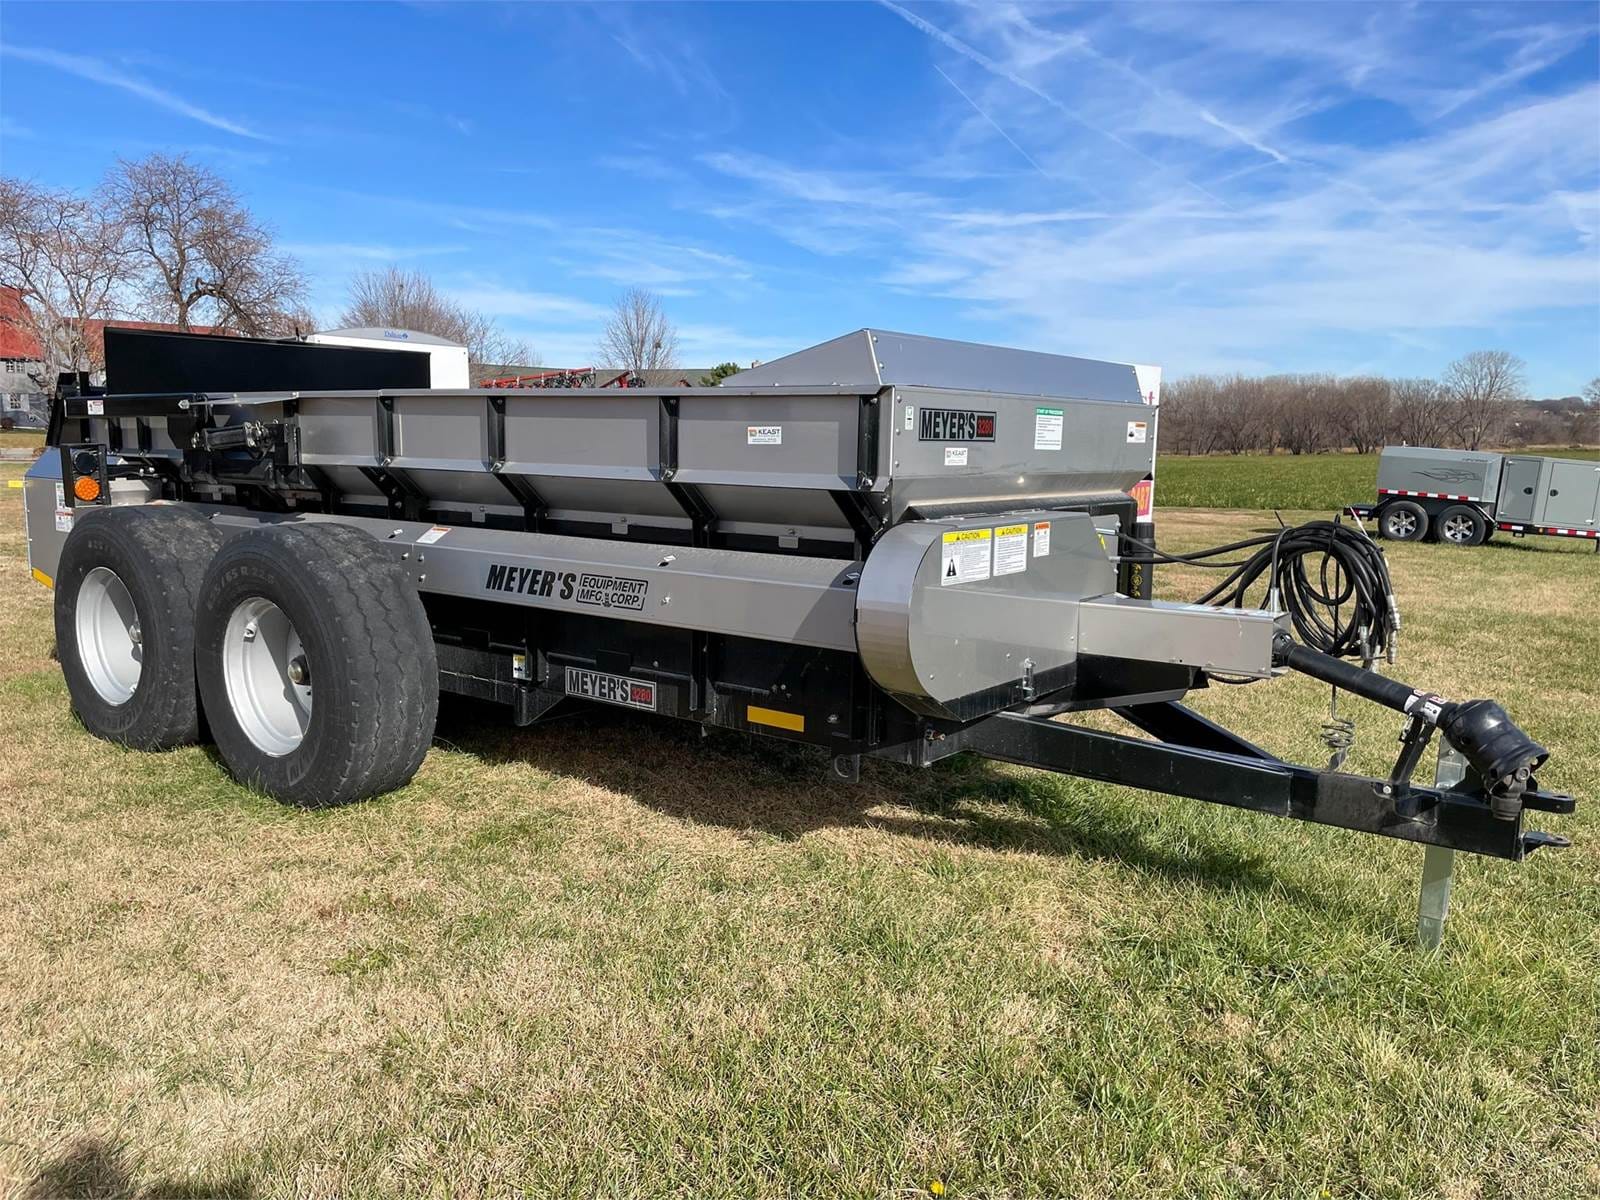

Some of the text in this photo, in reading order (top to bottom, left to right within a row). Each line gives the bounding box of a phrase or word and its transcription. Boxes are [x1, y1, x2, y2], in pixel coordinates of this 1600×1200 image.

[921, 411, 976, 440] MEYER'S
[960, 532, 981, 540] CAUTION
[485, 564, 577, 600] MEYER'S
[581, 577, 644, 593] EQUIPMENT
[610, 592, 641, 607] CORP.
[569, 671, 629, 702] MEYER'S
